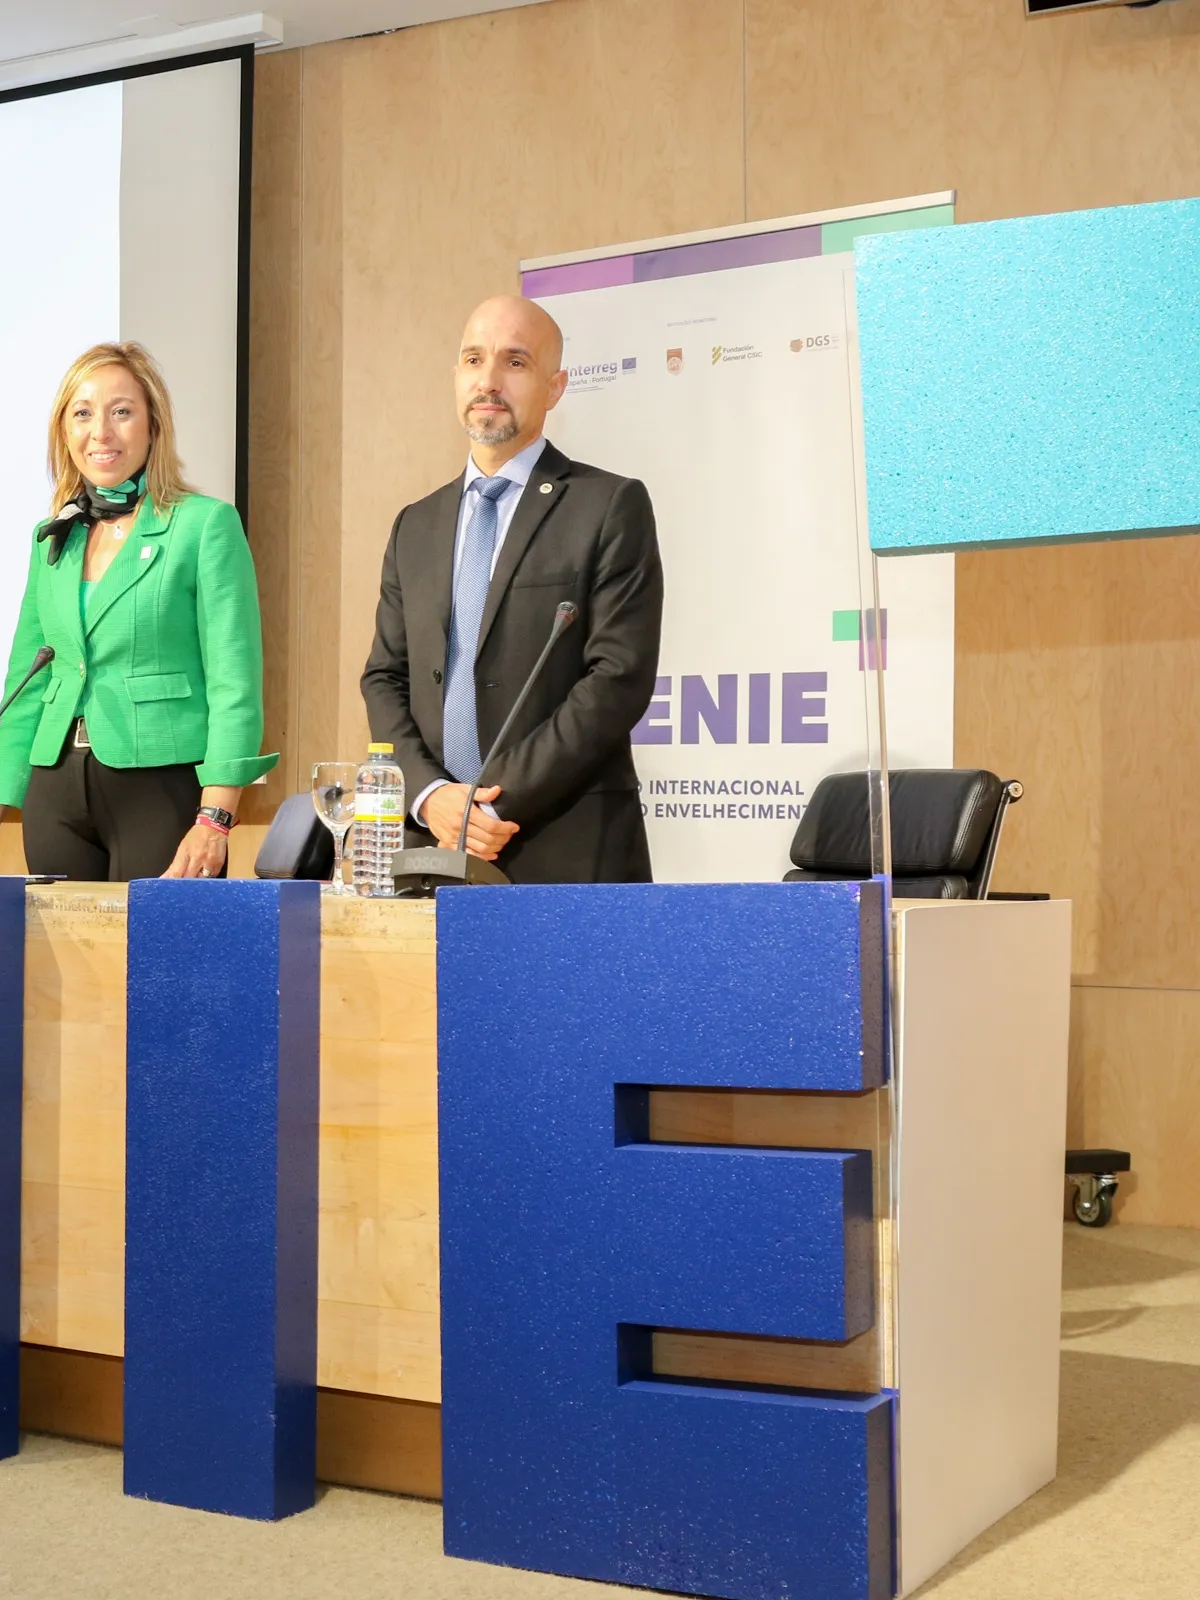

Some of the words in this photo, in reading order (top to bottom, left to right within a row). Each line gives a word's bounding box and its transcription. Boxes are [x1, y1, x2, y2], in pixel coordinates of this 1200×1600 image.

[806, 335, 830, 348] DGS
[723, 344, 754, 354] Fundación
[723, 354, 745, 362] General
[630, 671, 828, 745] ENIE
[650, 780, 804, 796] INTERNACIONAL
[655, 803, 808, 820] ENVELHECIMEN
